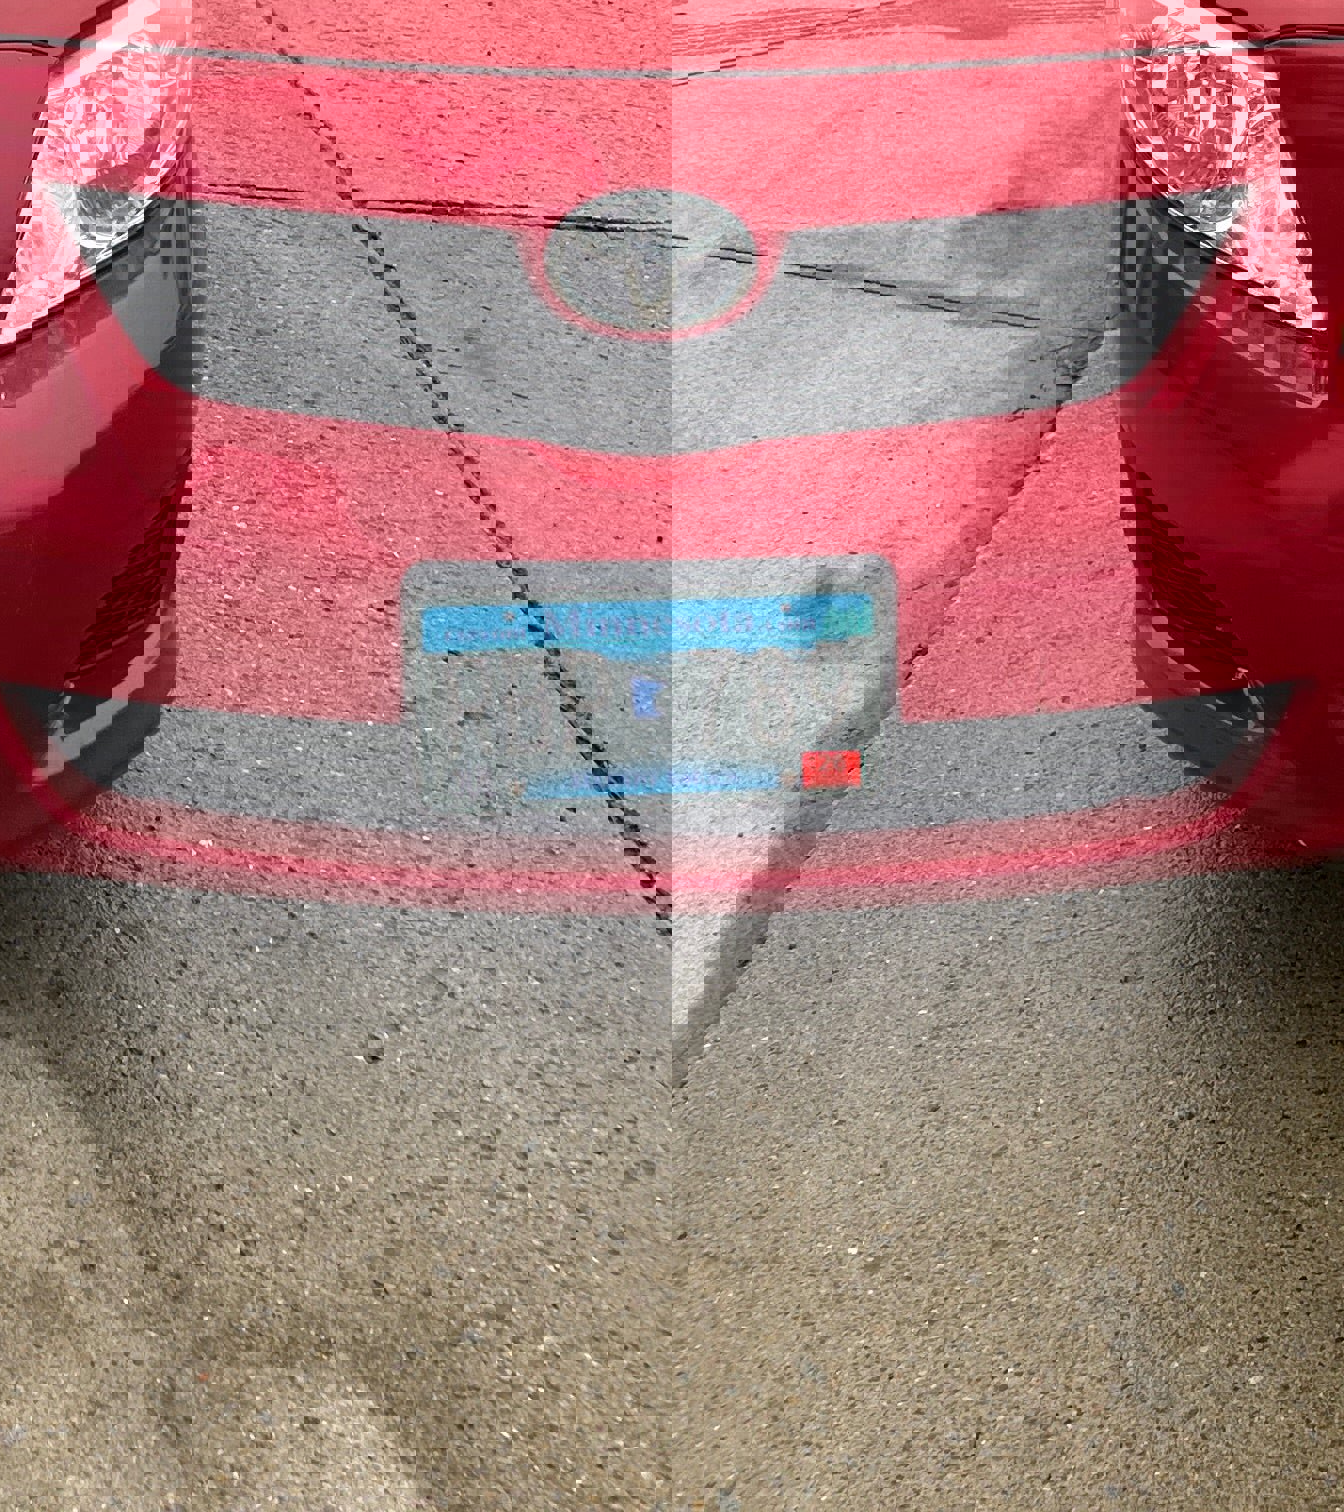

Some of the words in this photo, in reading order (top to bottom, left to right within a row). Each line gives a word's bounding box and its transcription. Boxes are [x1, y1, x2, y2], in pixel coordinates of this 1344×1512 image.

[444, 627, 531, 643] EXPLORE
[444, 651, 613, 759] RBP
[687, 643, 855, 749] 789
[817, 752, 847, 773] 26
[449, 765, 500, 799] JUL
[568, 768, 659, 792] 10,000
[667, 766, 741, 787] lakes
